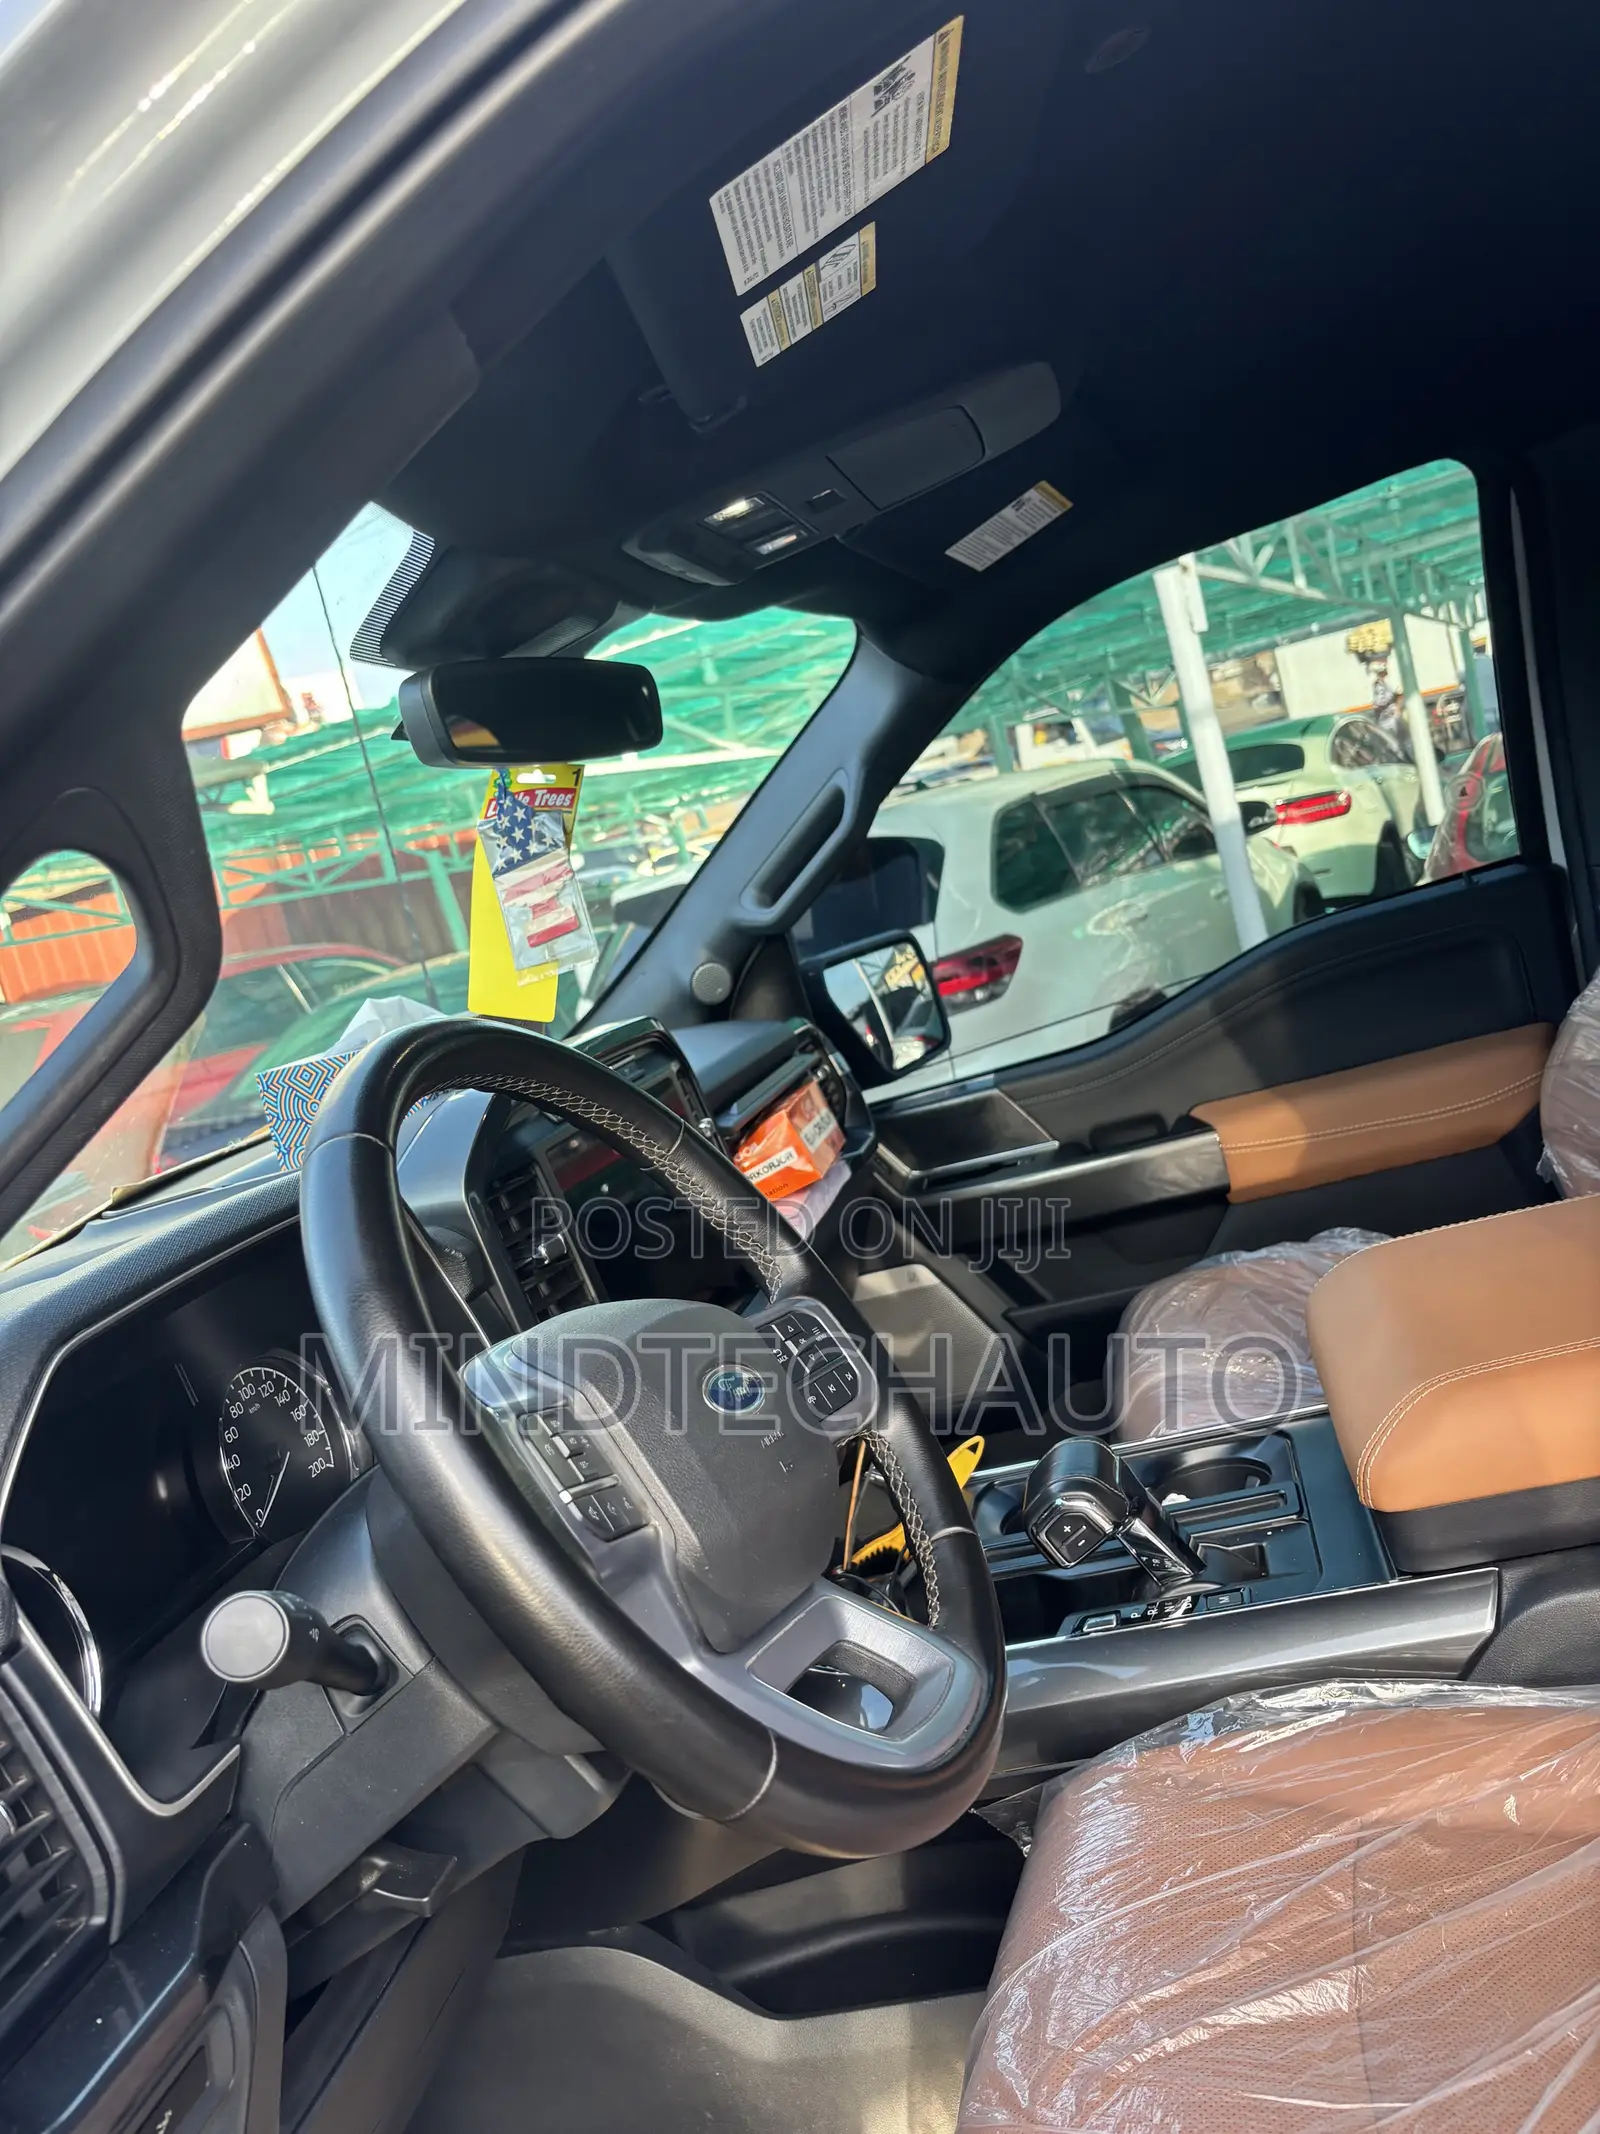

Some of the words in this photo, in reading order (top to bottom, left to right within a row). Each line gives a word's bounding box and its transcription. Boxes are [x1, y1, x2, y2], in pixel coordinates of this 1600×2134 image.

[572, 768, 582, 787] 1
[535, 789, 574, 807] Trees
[238, 1383, 256, 1402] 100
[258, 1380, 275, 1398] 120
[274, 1389, 291, 1407] 140
[228, 1401, 245, 1419] 80
[290, 1404, 307, 1422] 160
[224, 1426, 239, 1443] 60
[303, 1429, 320, 1447] 180
[226, 1453, 241, 1470] 40
[307, 1458, 327, 1478] 200
[237, 1483, 252, 1502] 20
[255, 1508, 264, 1522] 0
